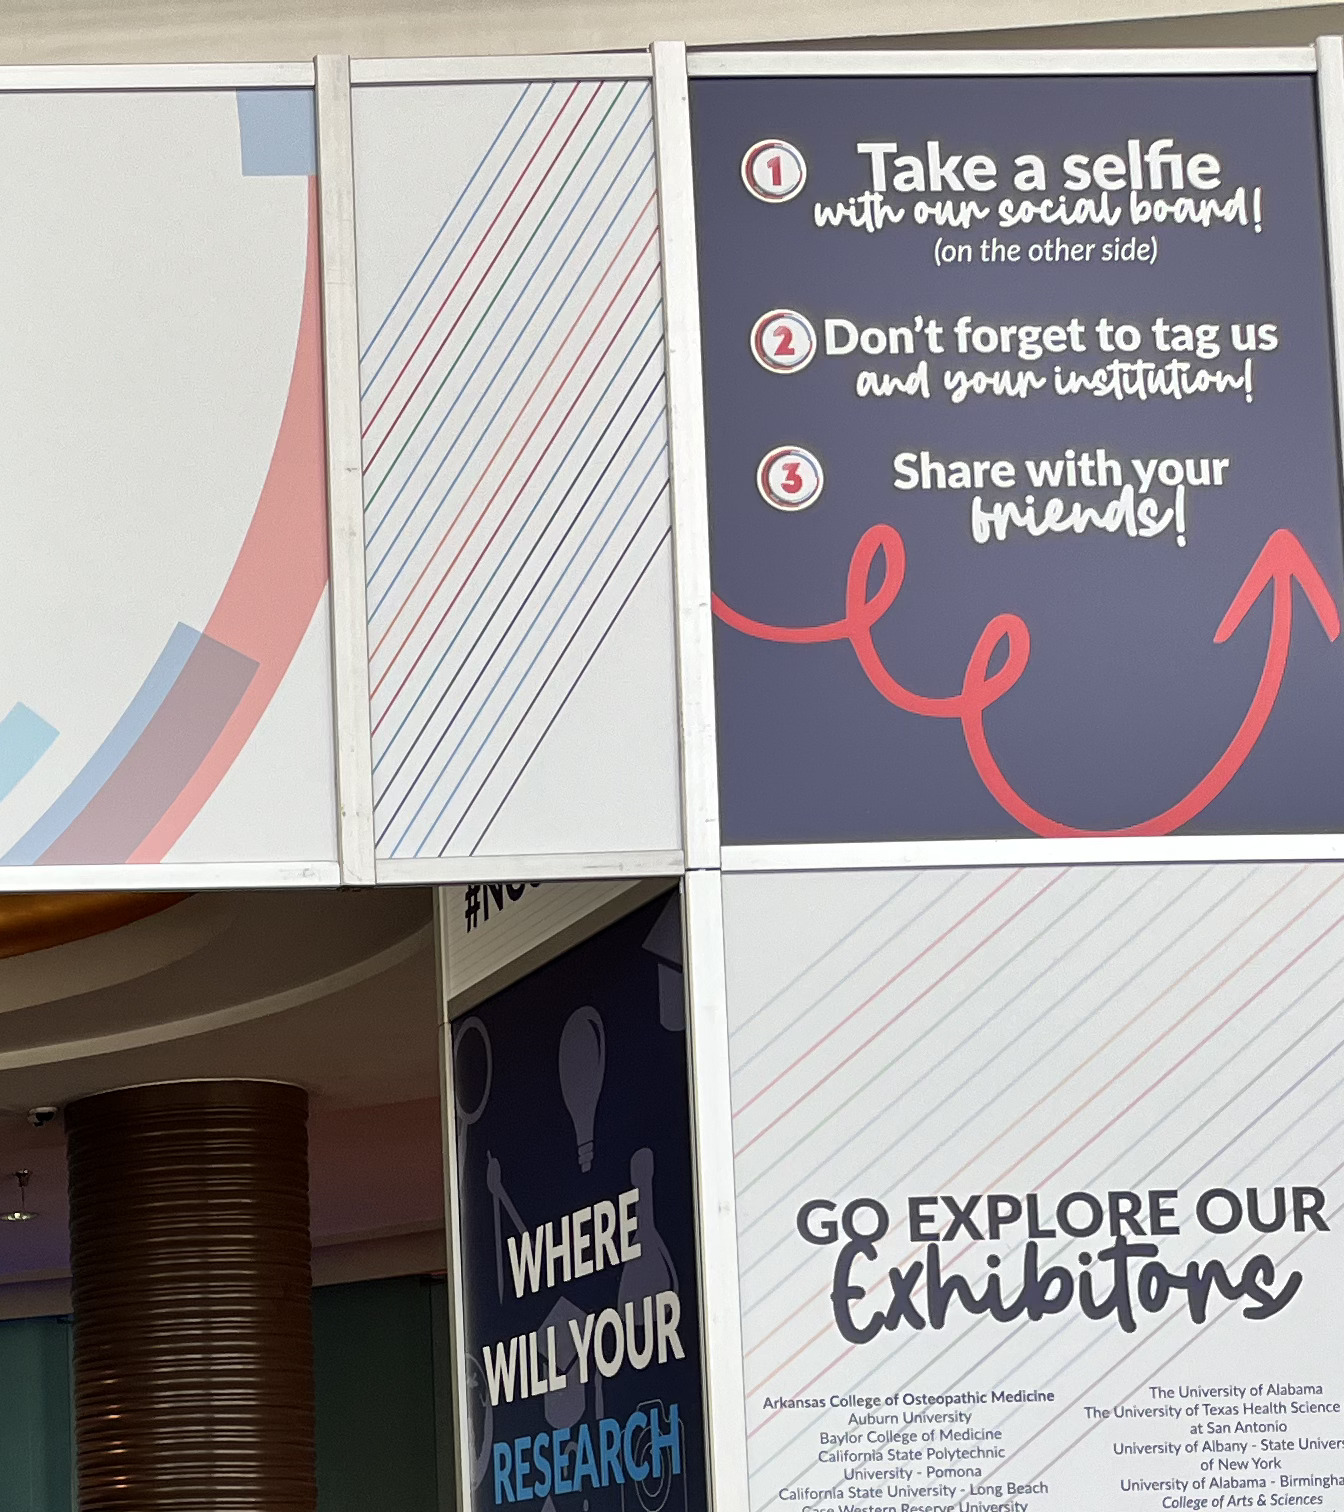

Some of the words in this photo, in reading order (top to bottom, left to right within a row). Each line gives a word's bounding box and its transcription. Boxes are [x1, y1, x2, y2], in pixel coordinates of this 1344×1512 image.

[764, 155, 783, 186] 1
[857, 141, 998, 193] Take
[1014, 153, 1046, 191] a
[1063, 139, 1222, 191] selfie
[814, 191, 906, 232] with
[914, 200, 991, 229] our
[999, 193, 1121, 228] social
[1131, 186, 1263, 234] board!
[933, 239, 972, 265] (on
[980, 239, 1021, 262] the
[1028, 238, 1095, 262] other
[1102, 236, 1159, 264] side)
[774, 327, 796, 356] 2
[824, 316, 944, 355] Don't
[954, 317, 1086, 360] forget
[1095, 318, 1140, 352] to
[1153, 317, 1220, 359] tag
[1232, 322, 1279, 352] us
[856, 362, 930, 398] and
[945, 372, 1047, 404] your
[1054, 359, 1253, 403] institution!
[781, 463, 803, 494] 3
[893, 451, 1016, 490] Share
[1024, 450, 1123, 489] with
[1131, 456, 1230, 492] your
[971, 484, 1187, 547] friends!
[796, 1198, 890, 1245] GO
[908, 1189, 1180, 1243] EXPLORE
[1196, 1186, 1330, 1234] OUR
[507, 1189, 642, 1299] WHERE
[830, 1236, 1303, 1345] Exhibitors
[482, 1336, 567, 1406] WILL
[571, 1291, 684, 1385] YOUR
[763, 1397, 826, 1409] Arkansas
[830, 1395, 881, 1409] College
[885, 1394, 899, 1406] of
[903, 1391, 987, 1407] Osteopathic
[991, 1390, 1055, 1403] Medicine
[1149, 1386, 1174, 1399] The
[1179, 1385, 1246, 1399] University
[1250, 1384, 1263, 1397] of
[1267, 1383, 1323, 1396] Alabama
[848, 1412, 898, 1426] Auburn
[903, 1411, 972, 1426] University
[492, 1404, 681, 1505] RESEARCH
[818, 1449, 883, 1463] California
[887, 1449, 923, 1461] State
[926, 1446, 1006, 1462] Polytechnic
